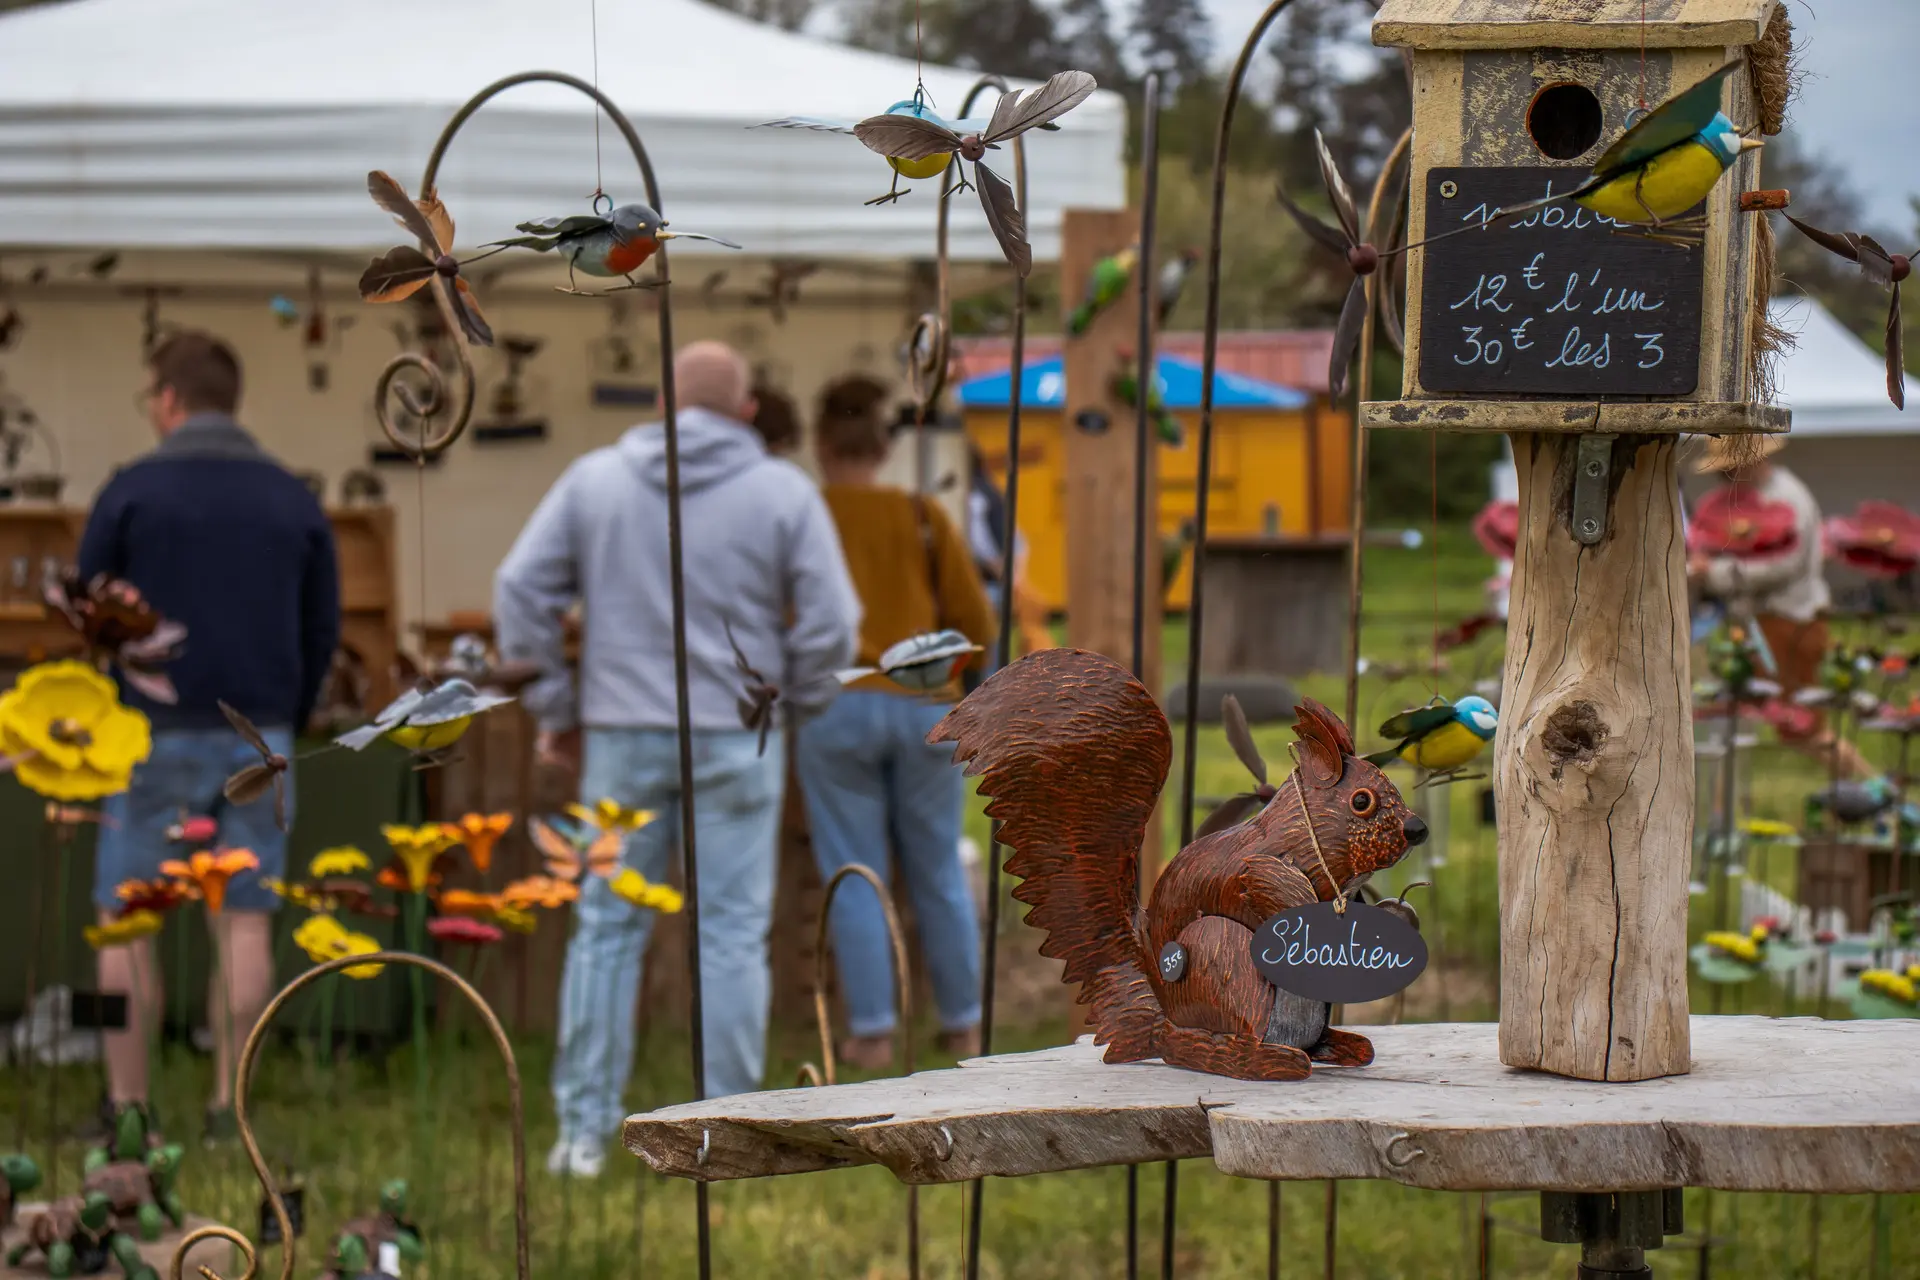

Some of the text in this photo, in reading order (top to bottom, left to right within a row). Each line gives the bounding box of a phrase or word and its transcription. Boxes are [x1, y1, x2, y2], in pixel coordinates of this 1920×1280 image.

[1546, 268, 1665, 315] l'un
[1545, 326, 1611, 369] les
[1634, 332, 1665, 369] 3
[1163, 950, 1183, 973] 35€
[1261, 916, 1414, 970] Sébastien
